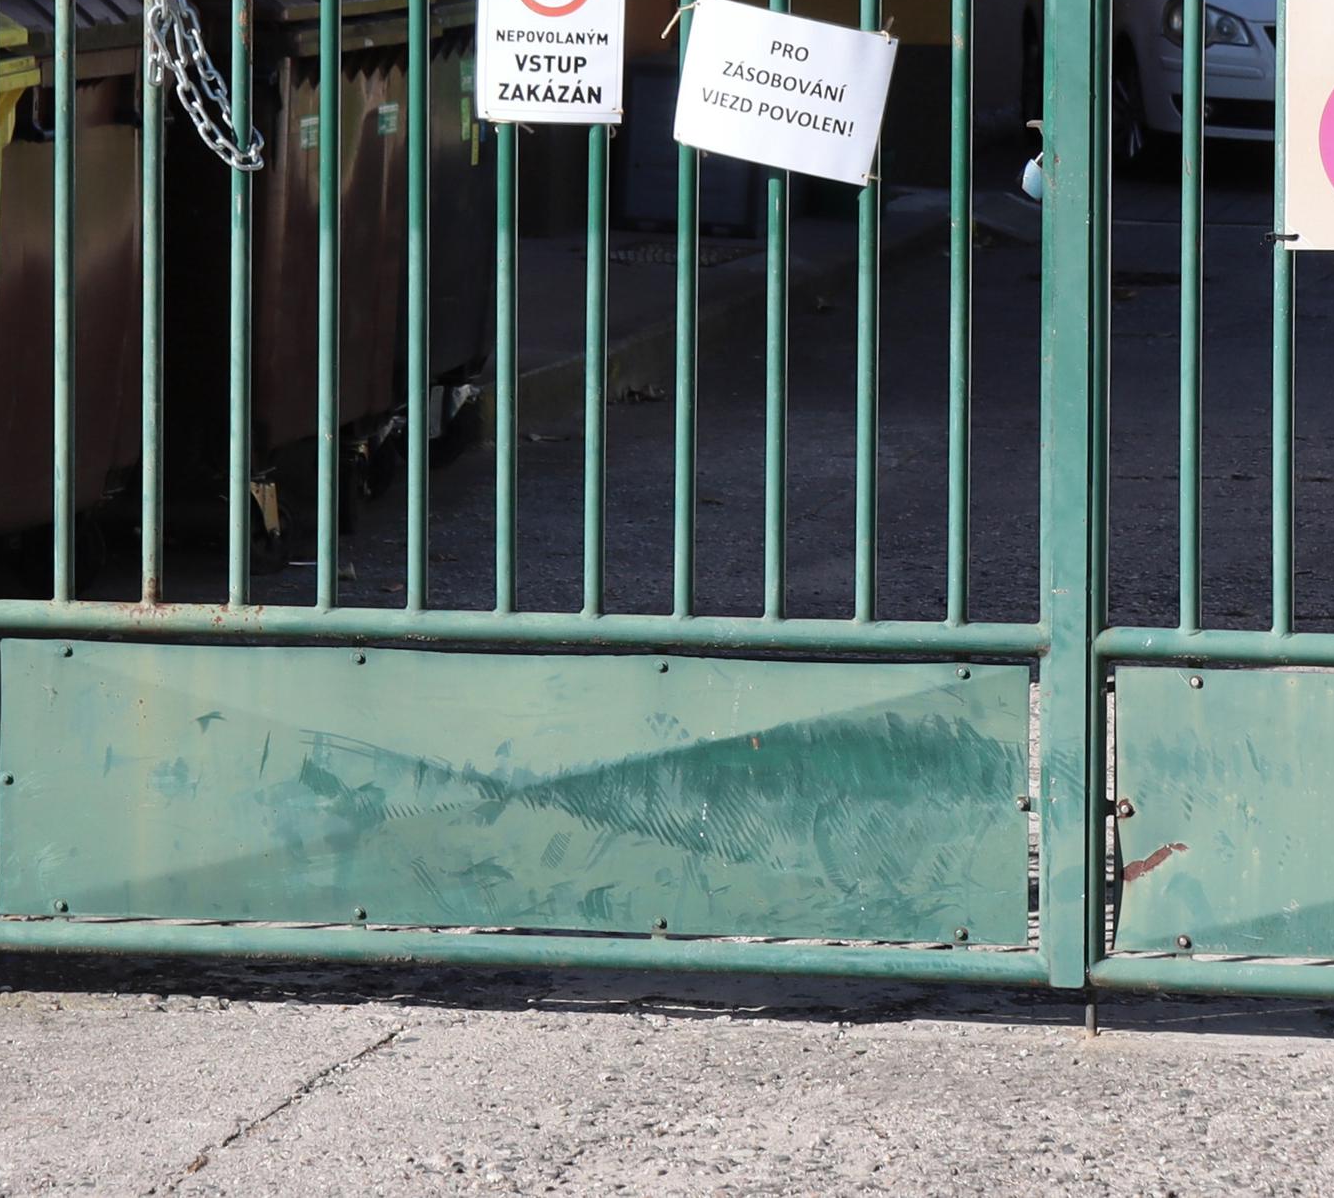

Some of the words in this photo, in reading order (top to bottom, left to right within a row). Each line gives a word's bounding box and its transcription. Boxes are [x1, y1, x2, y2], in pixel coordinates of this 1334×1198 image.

[496, 28, 609, 46] NEPOVOLANÝM
[770, 39, 810, 62] PRO
[515, 54, 588, 74] VSTUP
[498, 80, 602, 104] ZAKÁZÁN
[722, 60, 847, 103] ZÁSOBOVÁNÍ
[701, 87, 753, 114] VJEZD
[758, 103, 855, 138] POVOLEN!
